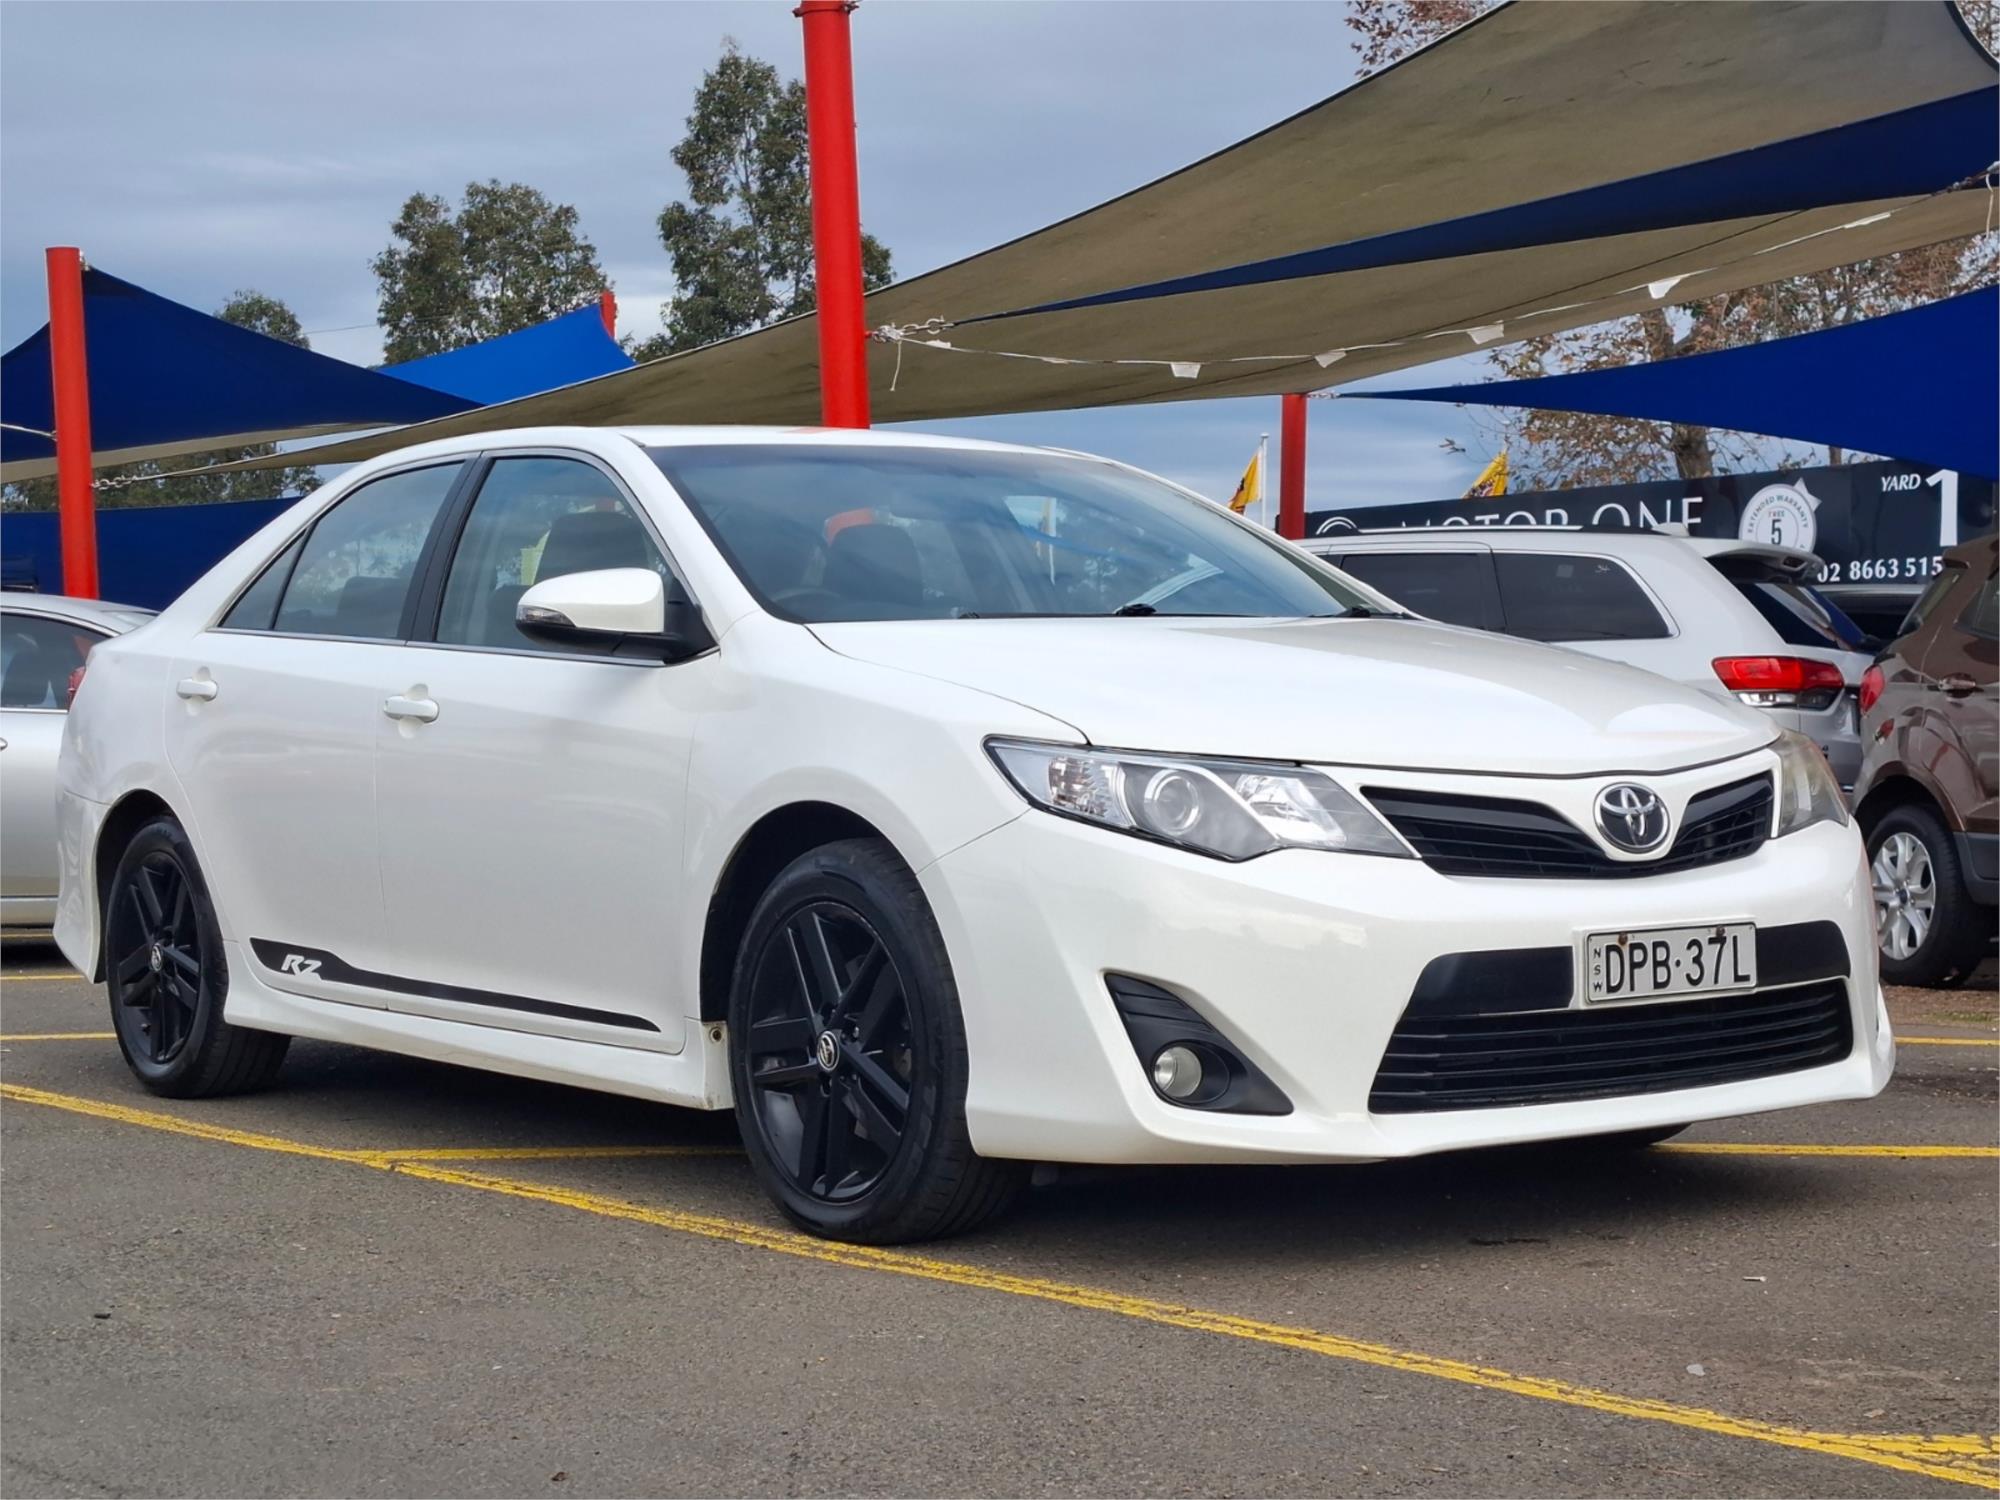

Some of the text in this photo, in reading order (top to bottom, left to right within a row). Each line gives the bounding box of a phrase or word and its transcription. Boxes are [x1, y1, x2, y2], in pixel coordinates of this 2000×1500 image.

[1881, 468, 1958, 547] YARD 1
[1771, 519, 1782, 545] 5
[1850, 558, 1899, 580] 8663
